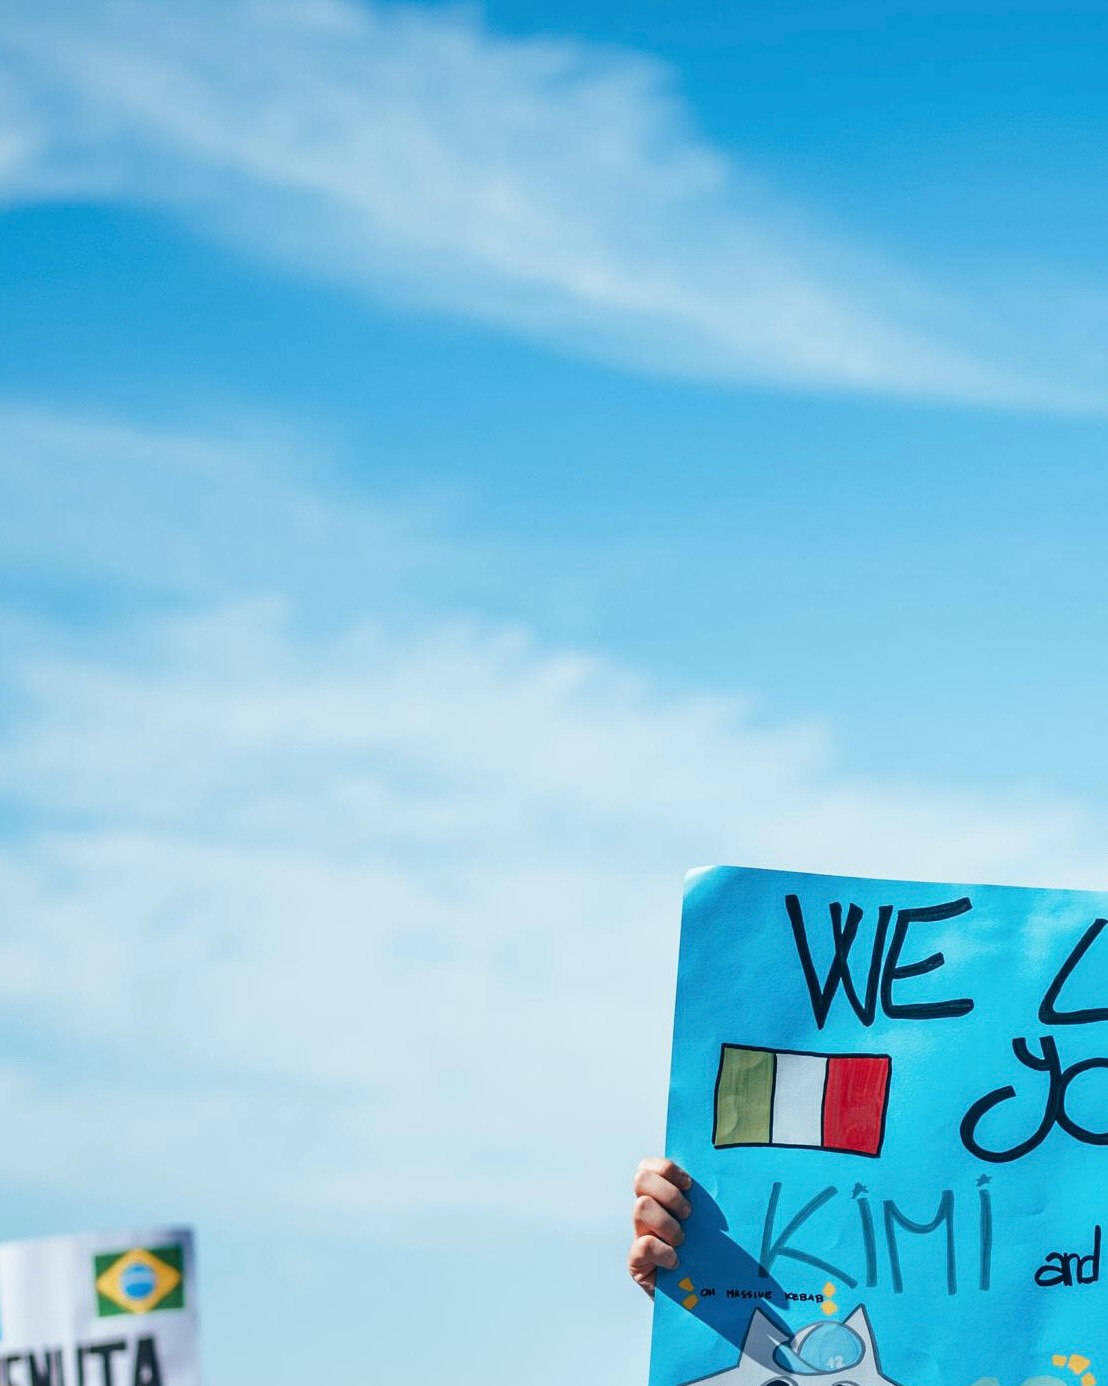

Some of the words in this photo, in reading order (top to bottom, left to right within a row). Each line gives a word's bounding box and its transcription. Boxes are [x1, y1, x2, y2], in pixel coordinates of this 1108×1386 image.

[785, 894, 976, 1030] WE
[1034, 1224, 1102, 1287] and
[726, 1289, 773, 1301] MASSIVE
[784, 1292, 825, 1304] KEBAB
[826, 1354, 845, 1369] 12
